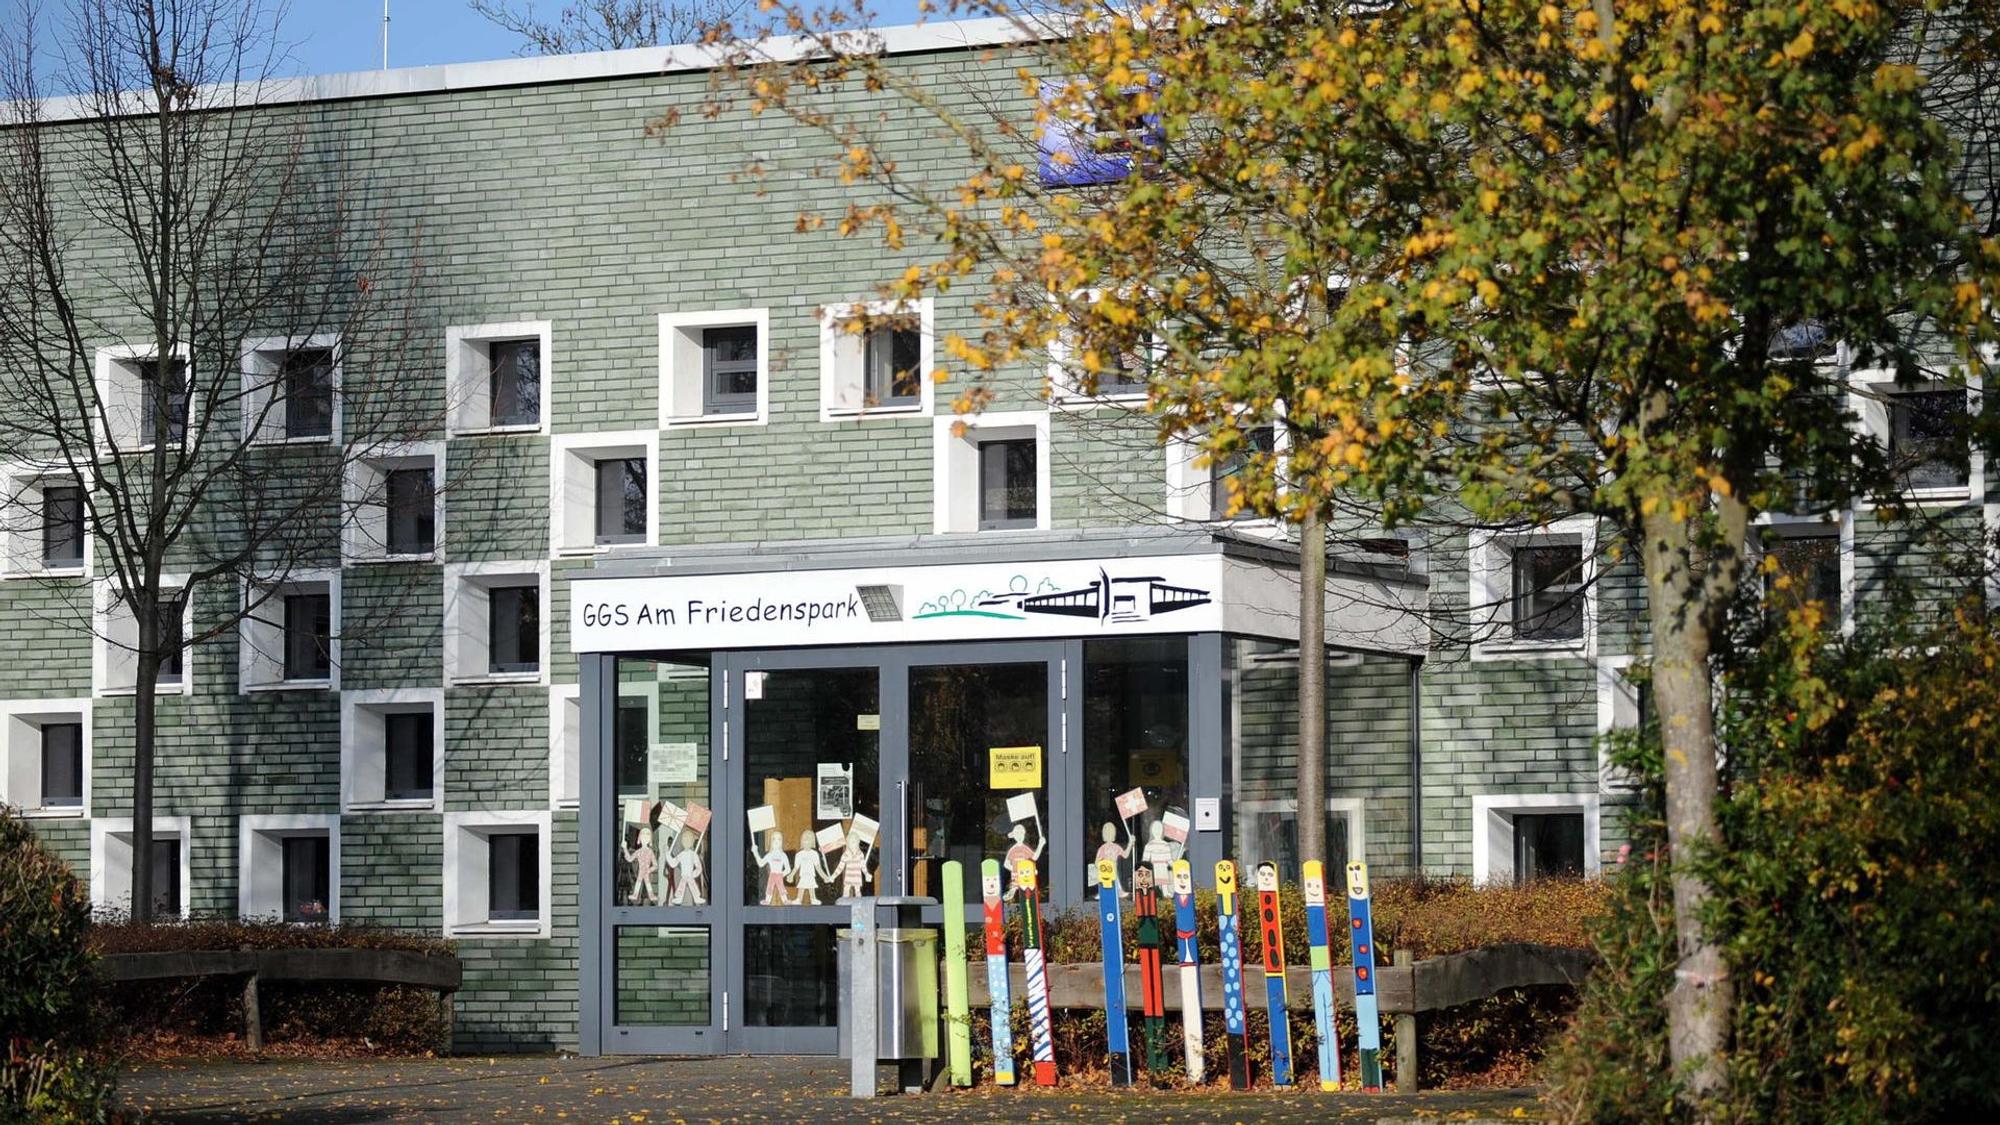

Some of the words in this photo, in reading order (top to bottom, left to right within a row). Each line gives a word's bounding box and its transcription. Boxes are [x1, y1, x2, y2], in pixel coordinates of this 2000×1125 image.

[583, 603, 629, 627] GGS
[637, 603, 676, 625] Am
[688, 594, 858, 627] Friedenspark
